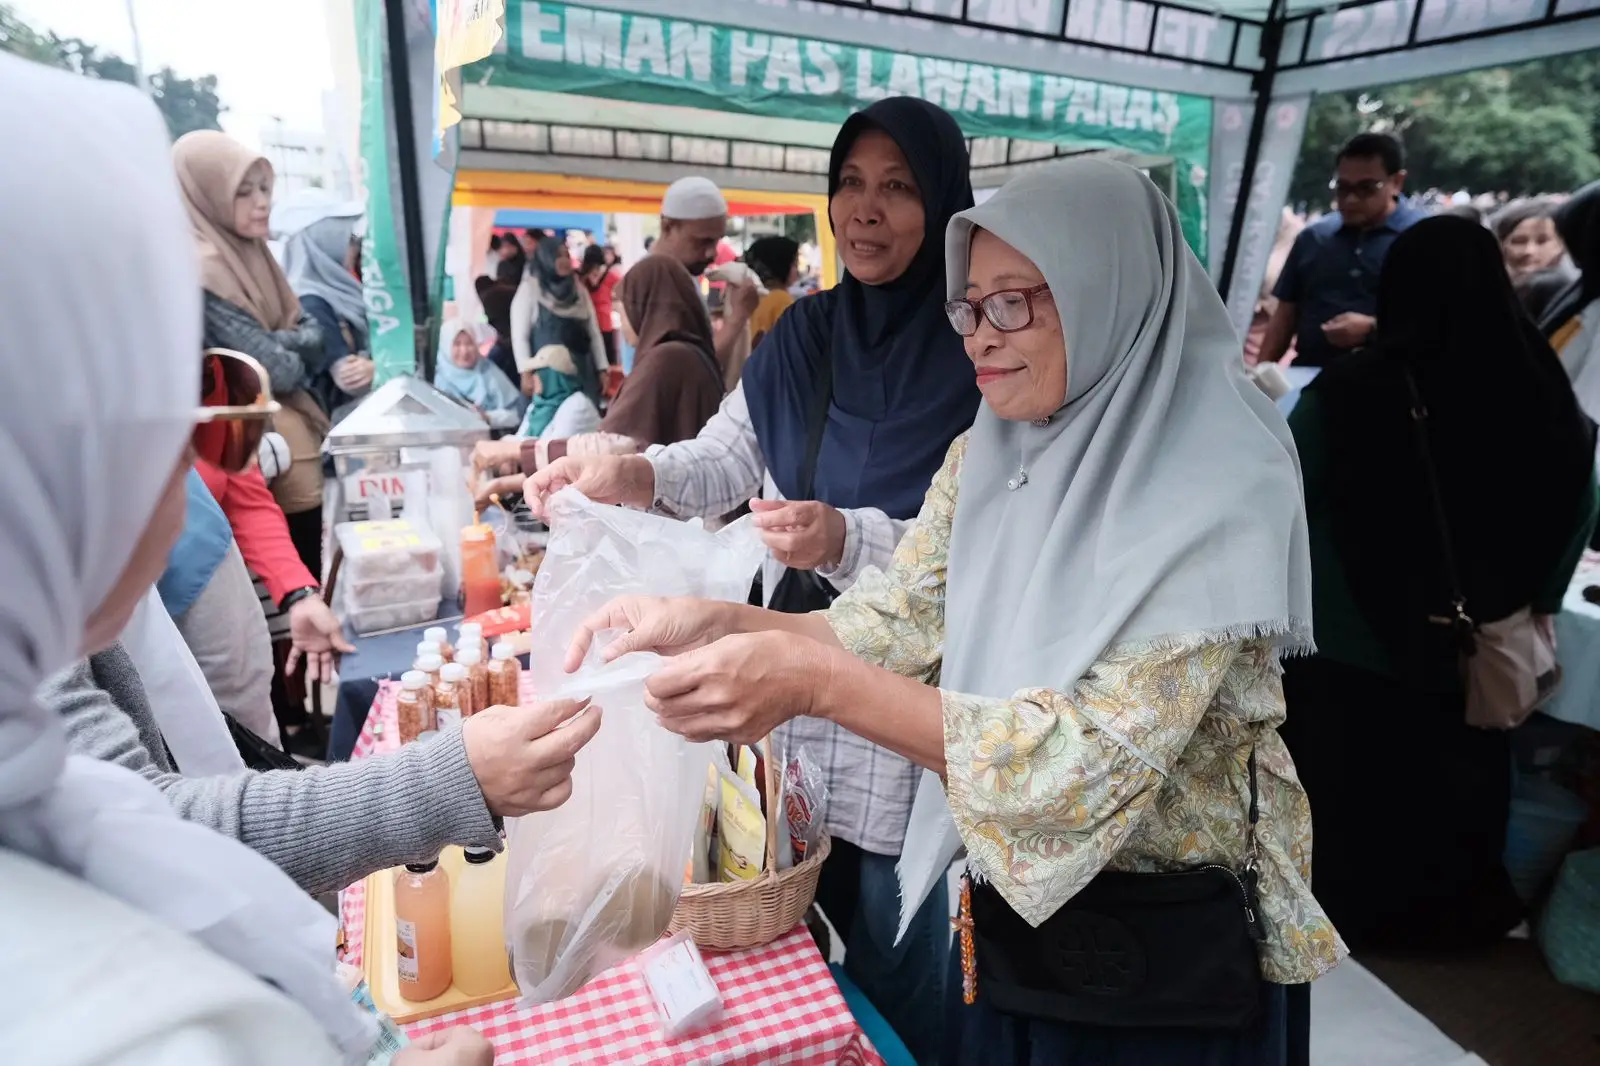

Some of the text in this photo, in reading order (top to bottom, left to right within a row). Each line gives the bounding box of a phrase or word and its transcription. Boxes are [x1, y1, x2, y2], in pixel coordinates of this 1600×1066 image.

[496, 0, 714, 82] EMAN
[729, 30, 842, 96] PAS
[856, 48, 1031, 119] LAWAN
[1042, 74, 1181, 133] PANAS
